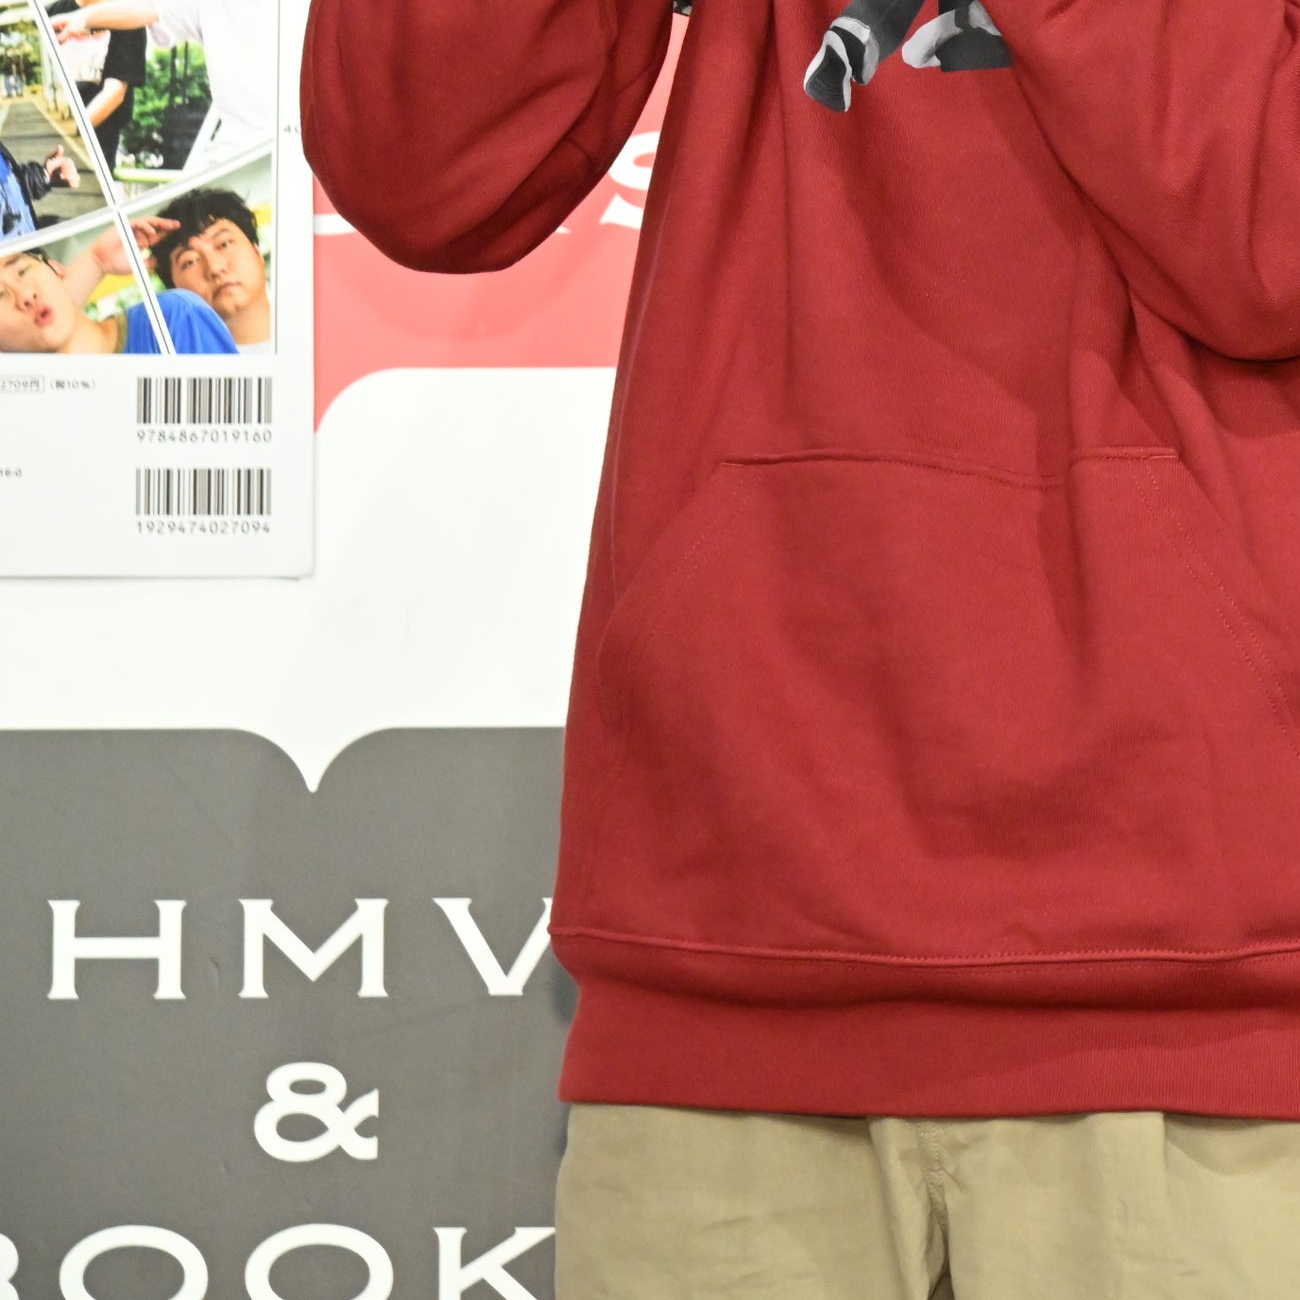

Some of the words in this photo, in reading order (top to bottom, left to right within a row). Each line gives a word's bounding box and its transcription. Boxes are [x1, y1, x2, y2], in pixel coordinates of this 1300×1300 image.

[136, 428, 272, 444] 9784867019160
[137, 520, 271, 535] 1929474027094
[48, 898, 553, 999] HMV
[253, 1061, 380, 1163] &
[0, 1223, 556, 1300] OOK
